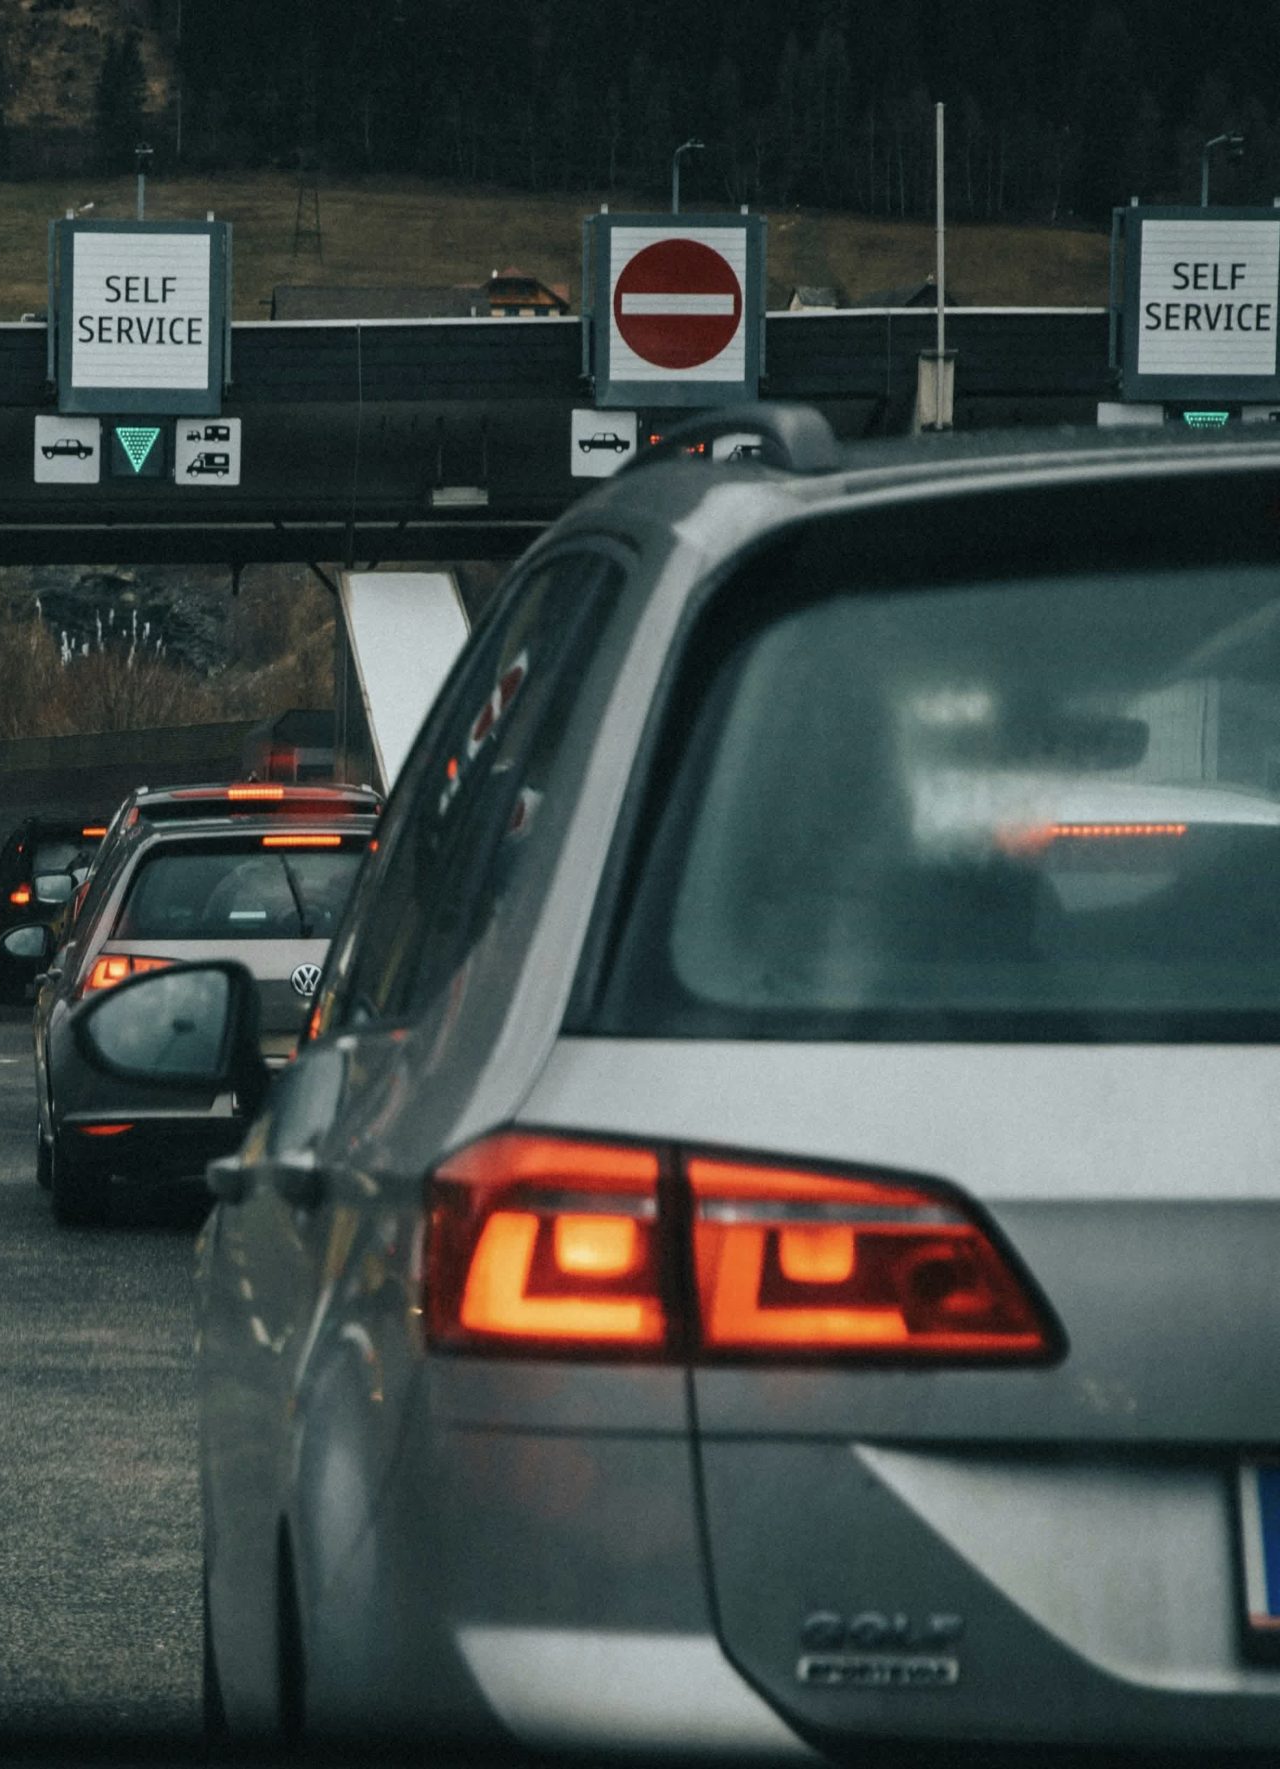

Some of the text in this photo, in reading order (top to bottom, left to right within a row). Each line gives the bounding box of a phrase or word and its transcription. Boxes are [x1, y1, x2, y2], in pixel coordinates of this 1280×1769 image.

[105, 275, 177, 303] SELF
[1172, 262, 1247, 290] SELF
[78, 315, 203, 345] SERVICE
[1144, 302, 1271, 331] SERVICE
